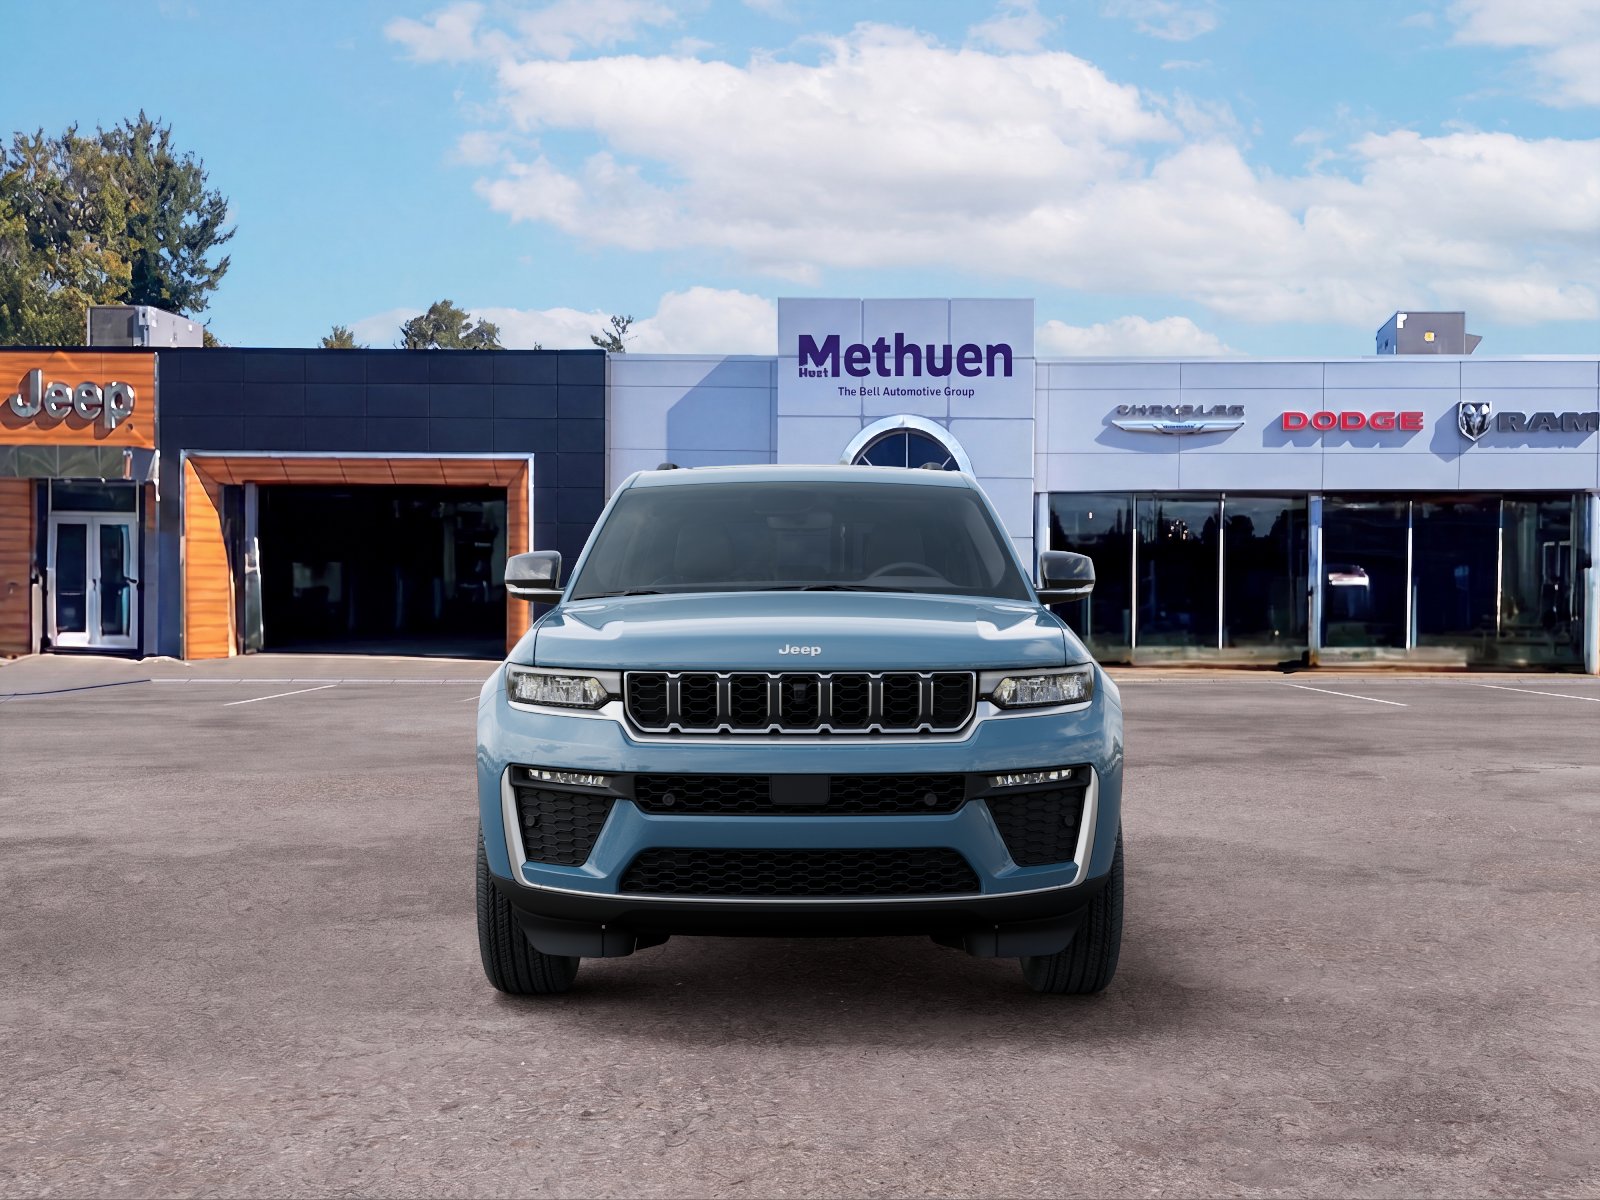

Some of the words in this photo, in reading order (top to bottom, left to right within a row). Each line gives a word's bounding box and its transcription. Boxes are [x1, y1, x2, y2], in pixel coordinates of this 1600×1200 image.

[798, 333, 1013, 378] Methuen
[9, 369, 135, 429] Jeep
[838, 386, 857, 397] The
[860, 386, 880, 397] Bell
[883, 386, 941, 397] Automotive
[944, 386, 975, 398] Group
[1282, 411, 1424, 431] DODGE
[1498, 411, 1599, 432] RAM
[778, 643, 822, 657] Jeep
